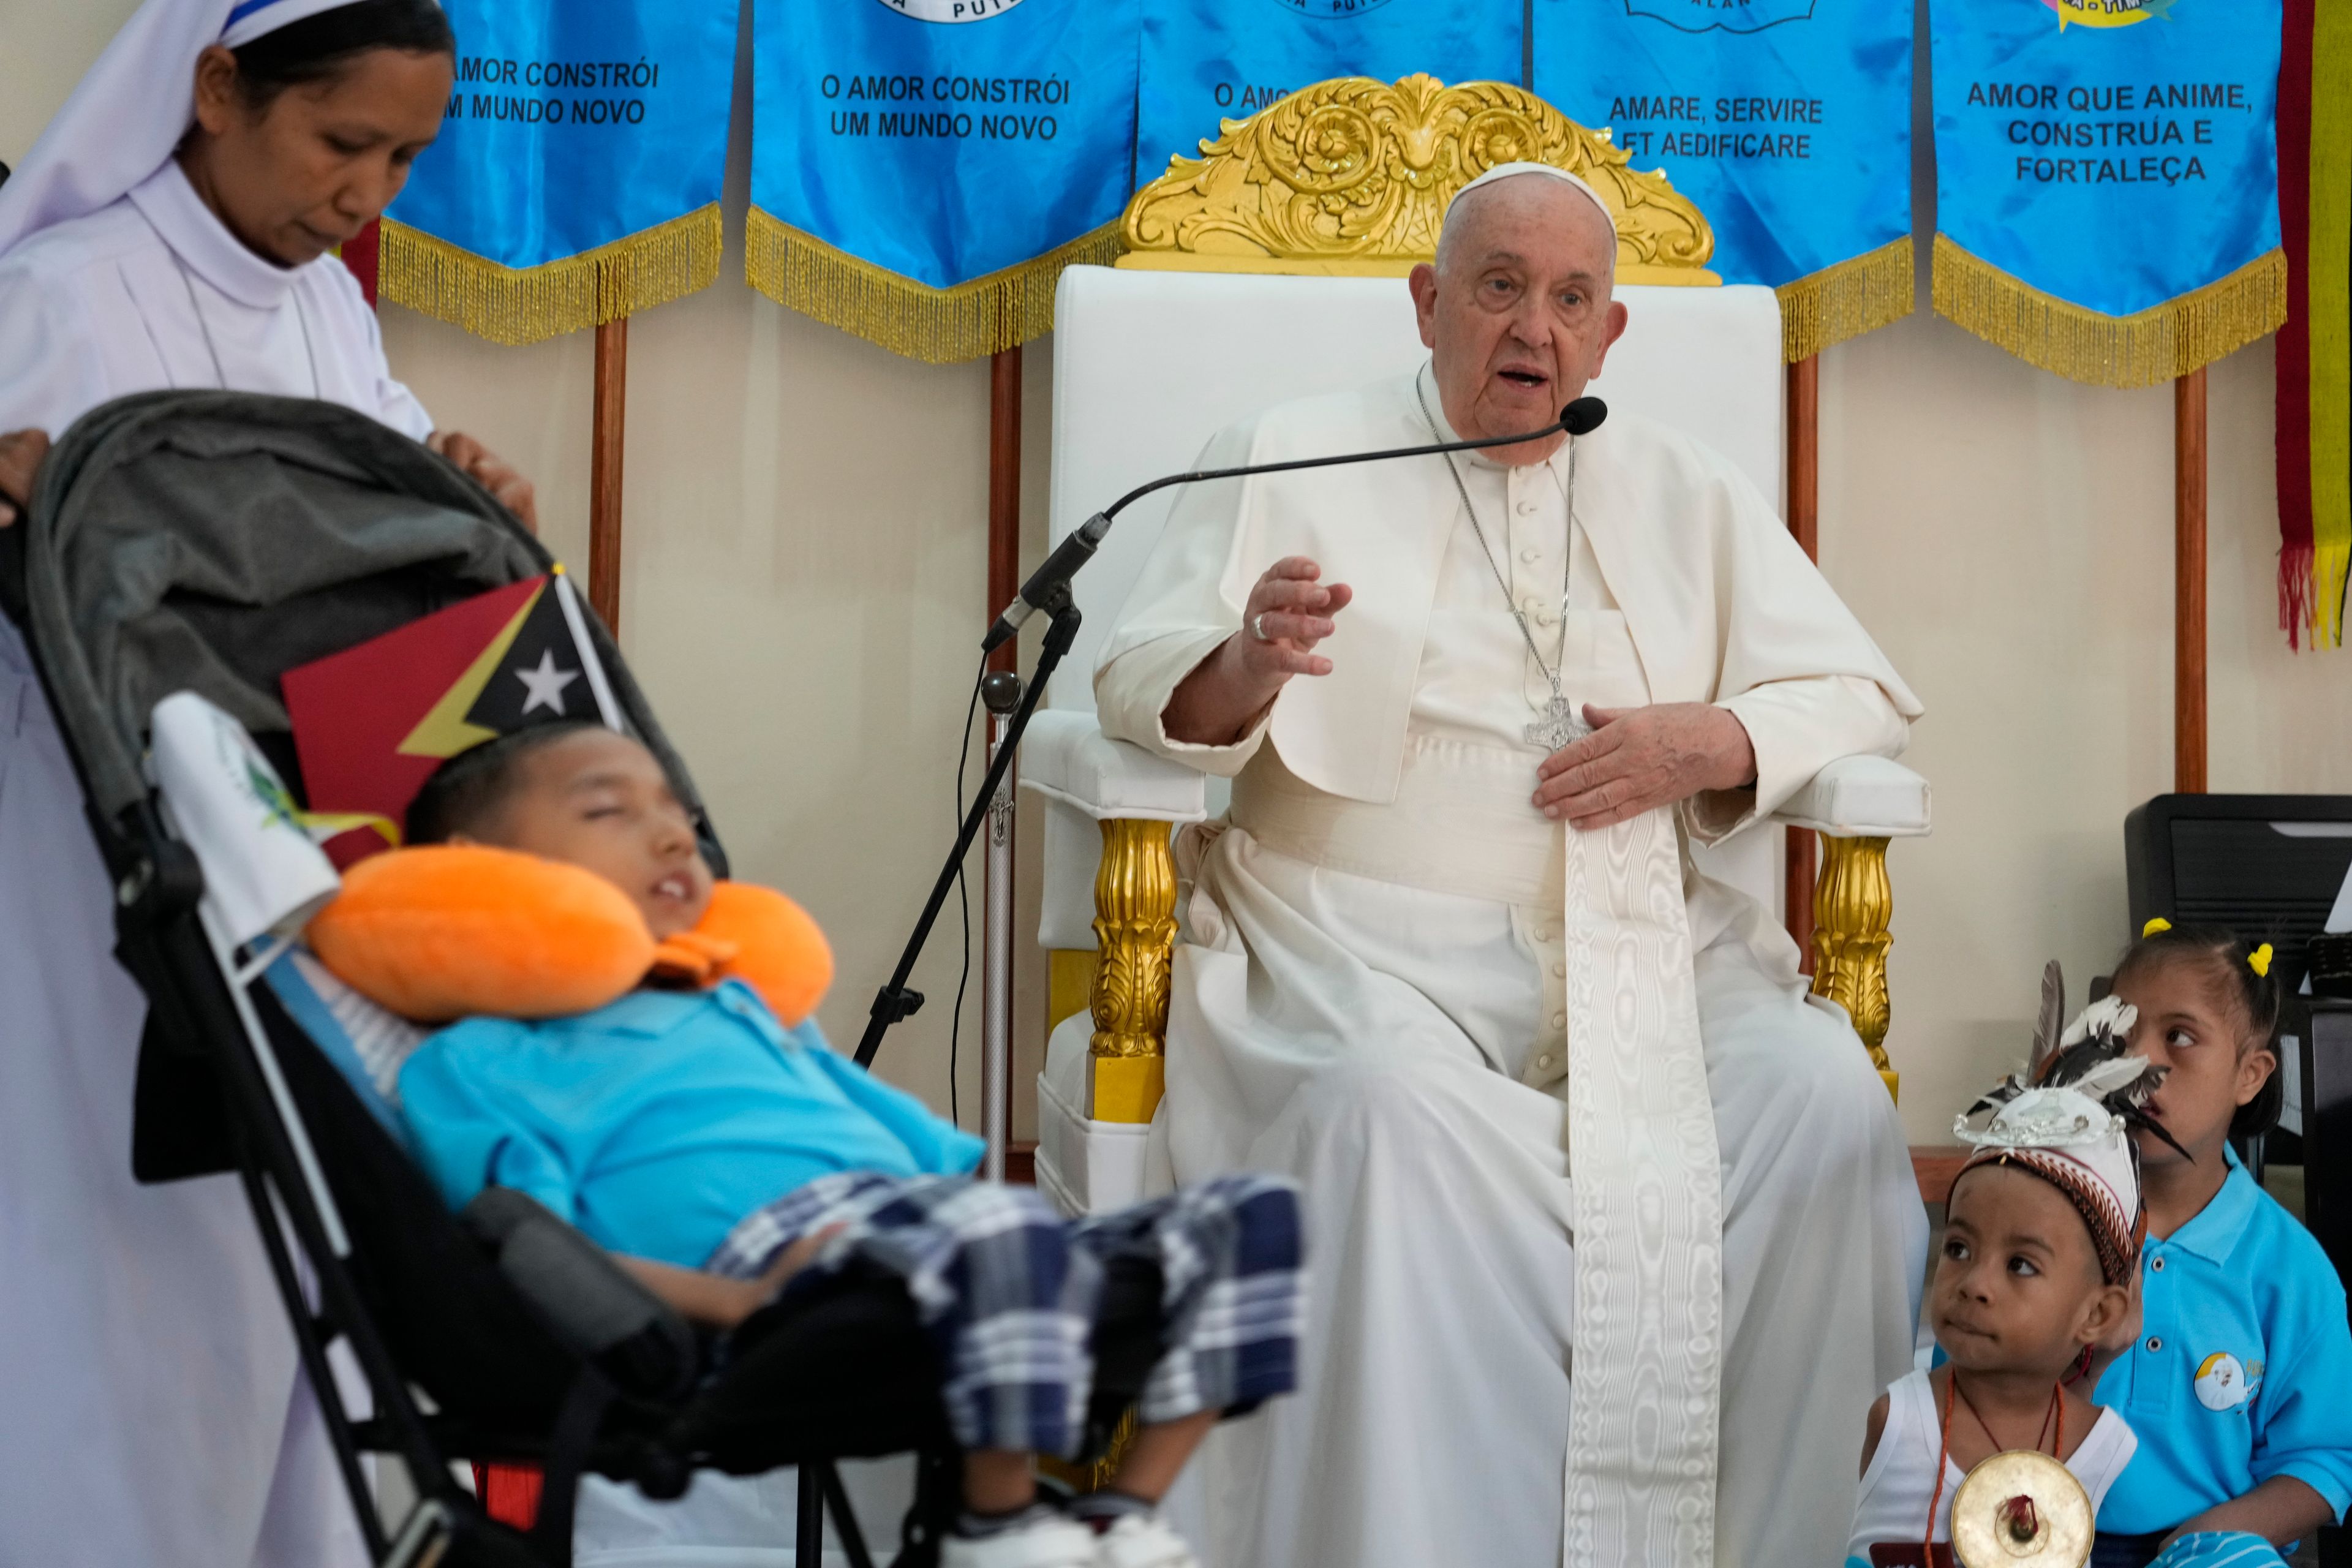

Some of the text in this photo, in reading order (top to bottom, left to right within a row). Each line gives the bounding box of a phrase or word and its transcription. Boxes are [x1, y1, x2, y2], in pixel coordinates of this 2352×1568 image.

[526, 55, 658, 88] CONSTRÓI
[821, 73, 1069, 104] O AMOR CONSTRÓI
[1215, 83, 1234, 107] O
[1967, 83, 2252, 113] AMOR QUE ANIME,
[472, 94, 564, 124] MUNDO
[571, 99, 645, 124] NOVO
[1609, 96, 1822, 124] AMARE, SERVIRE
[831, 111, 1057, 141] UM MUNDO NOVO
[2194, 119, 2212, 144] E
[1621, 131, 1810, 158] ET AEDIFICARE
[2017, 156, 2206, 187] FORTALEÇA
